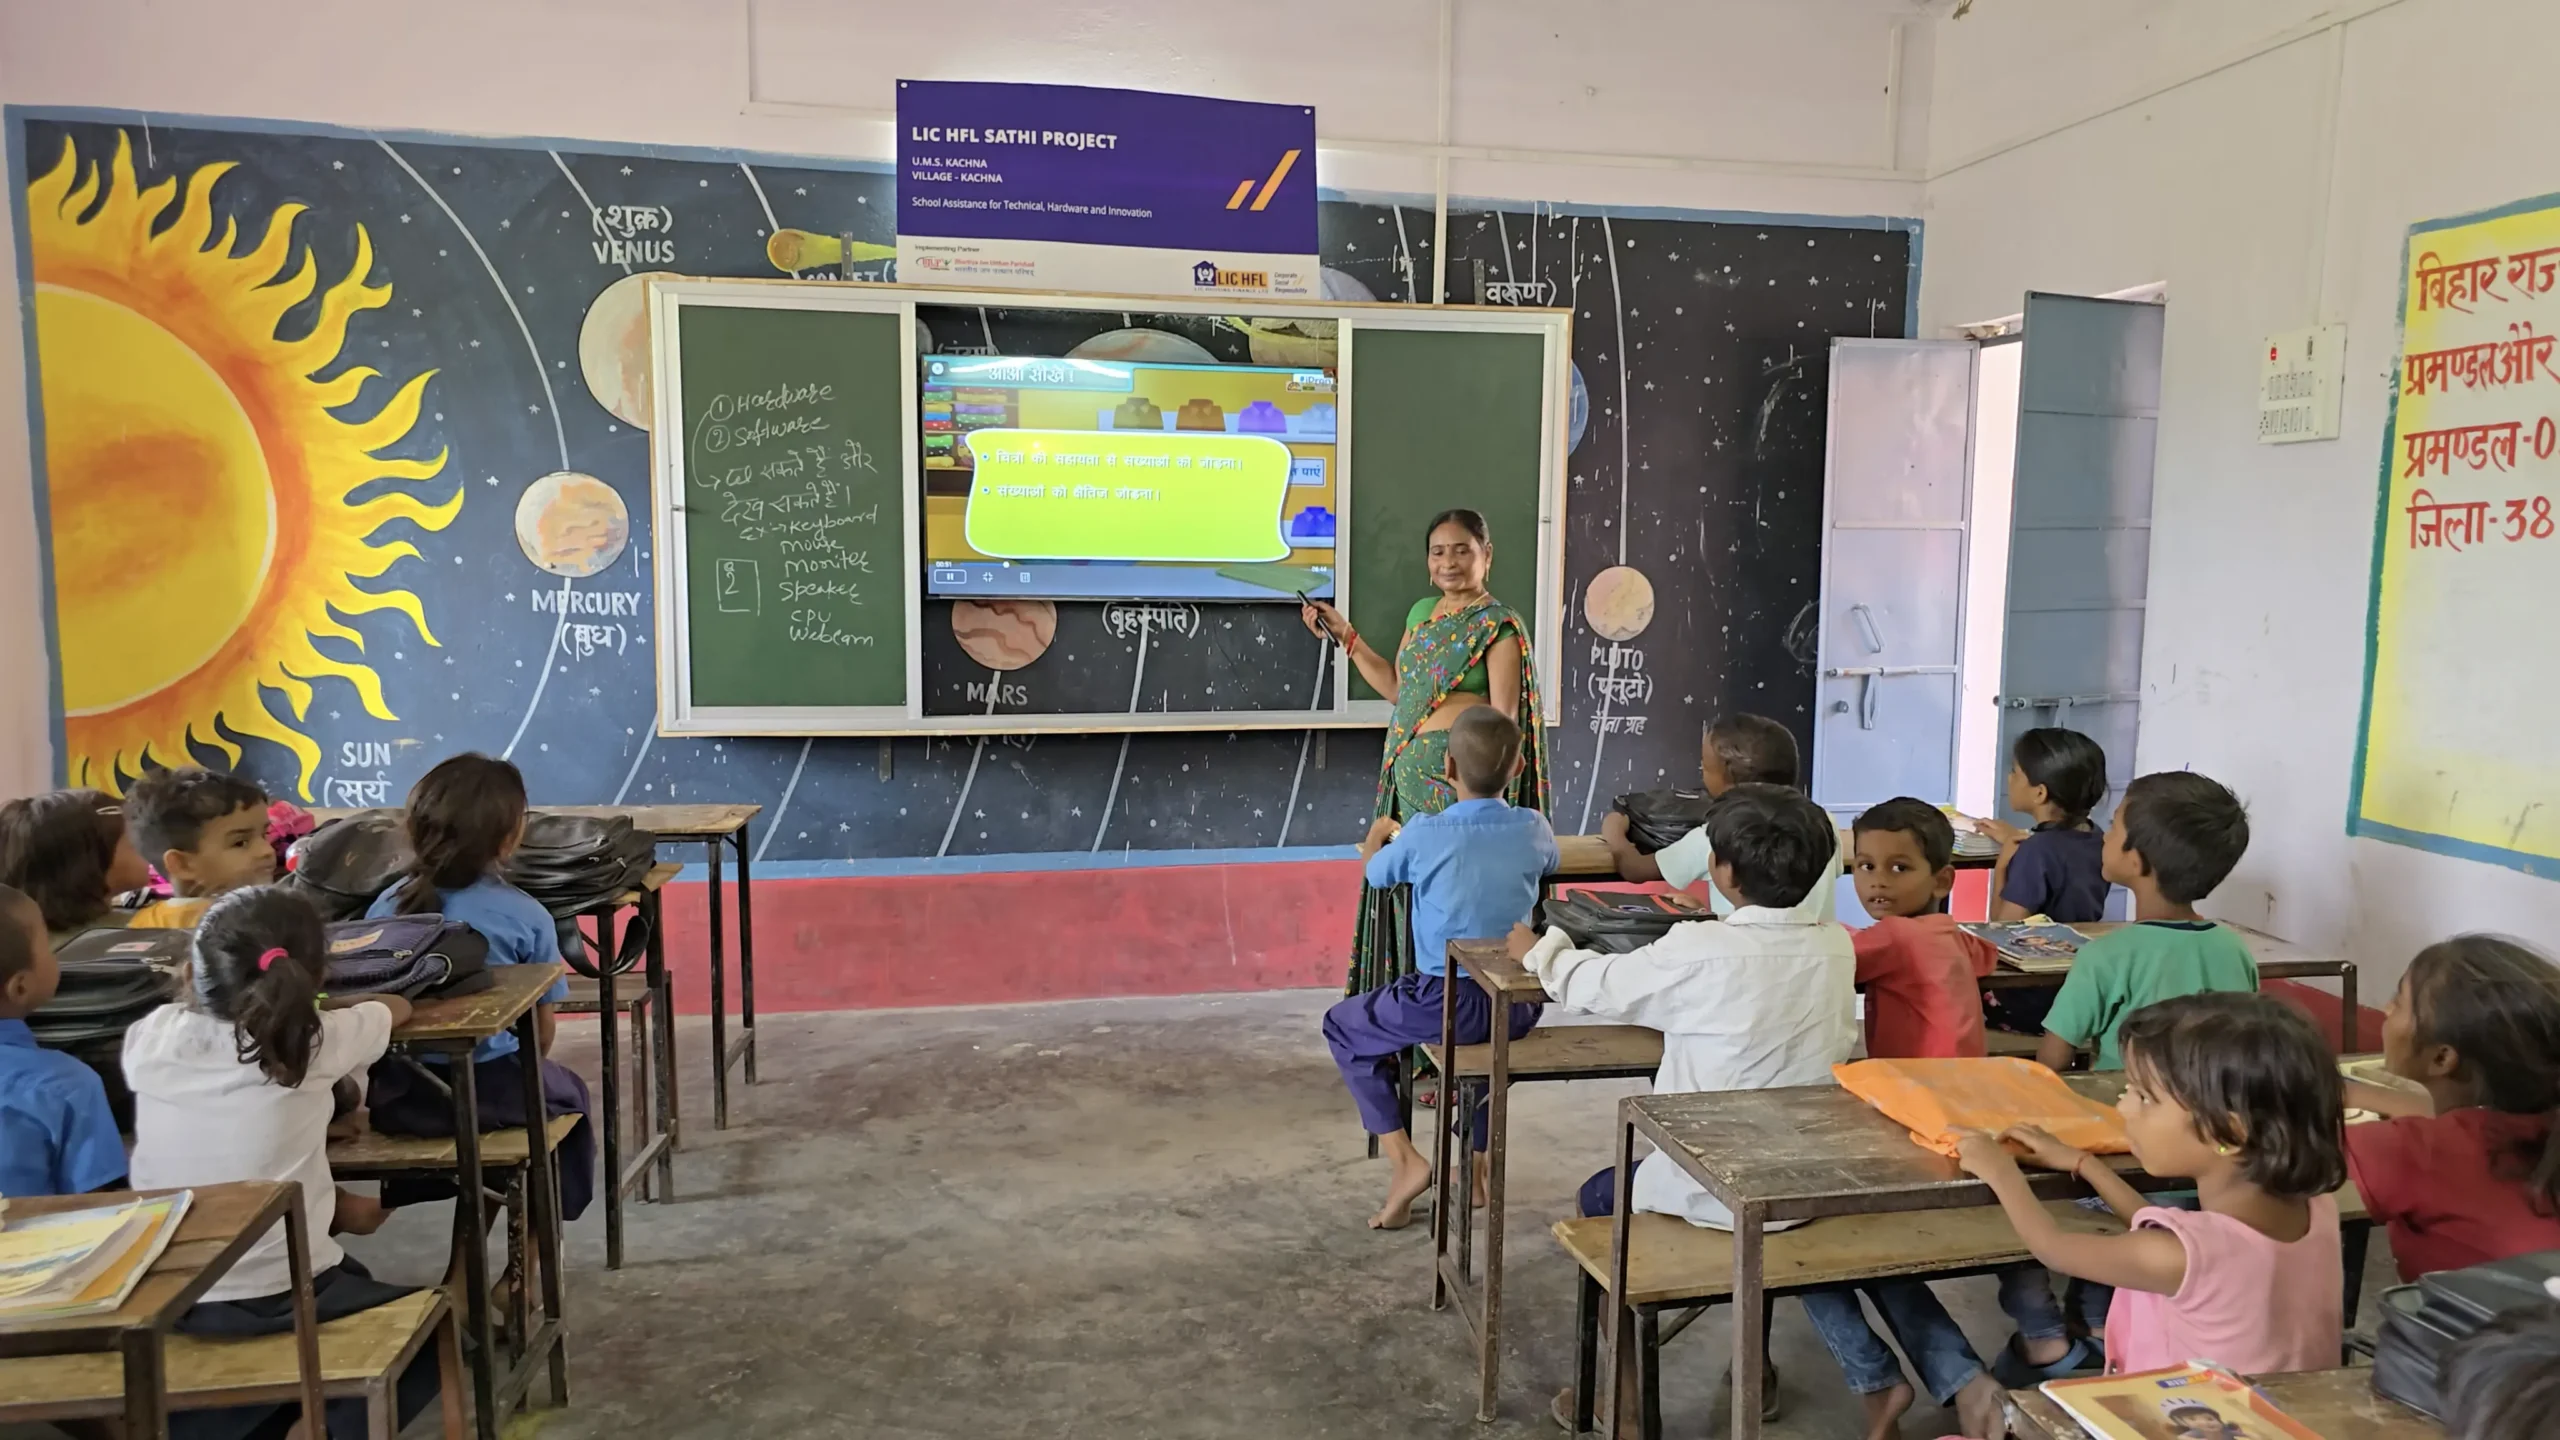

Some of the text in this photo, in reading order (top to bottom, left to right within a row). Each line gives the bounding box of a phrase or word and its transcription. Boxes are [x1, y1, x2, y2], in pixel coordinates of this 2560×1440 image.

[912, 126, 1117, 151] LIC HFL SATHI PROJECT
[912, 157, 988, 168] U.M.S. KACHNA
[912, 171, 952, 182] VILLAGE
[960, 173, 1003, 183] KACHNA
[912, 196, 1152, 218] School Assistance for Technical, Hardware and Innovation
[592, 240, 675, 264] VENUS
[1217, 271, 1267, 287] LIC HFL
[2416, 251, 2508, 314] बिहार
[531, 589, 641, 617] MERCURY
[1590, 645, 1644, 671] PLUTO
[966, 681, 1028, 706] MARS
[341, 741, 391, 768] SUN
